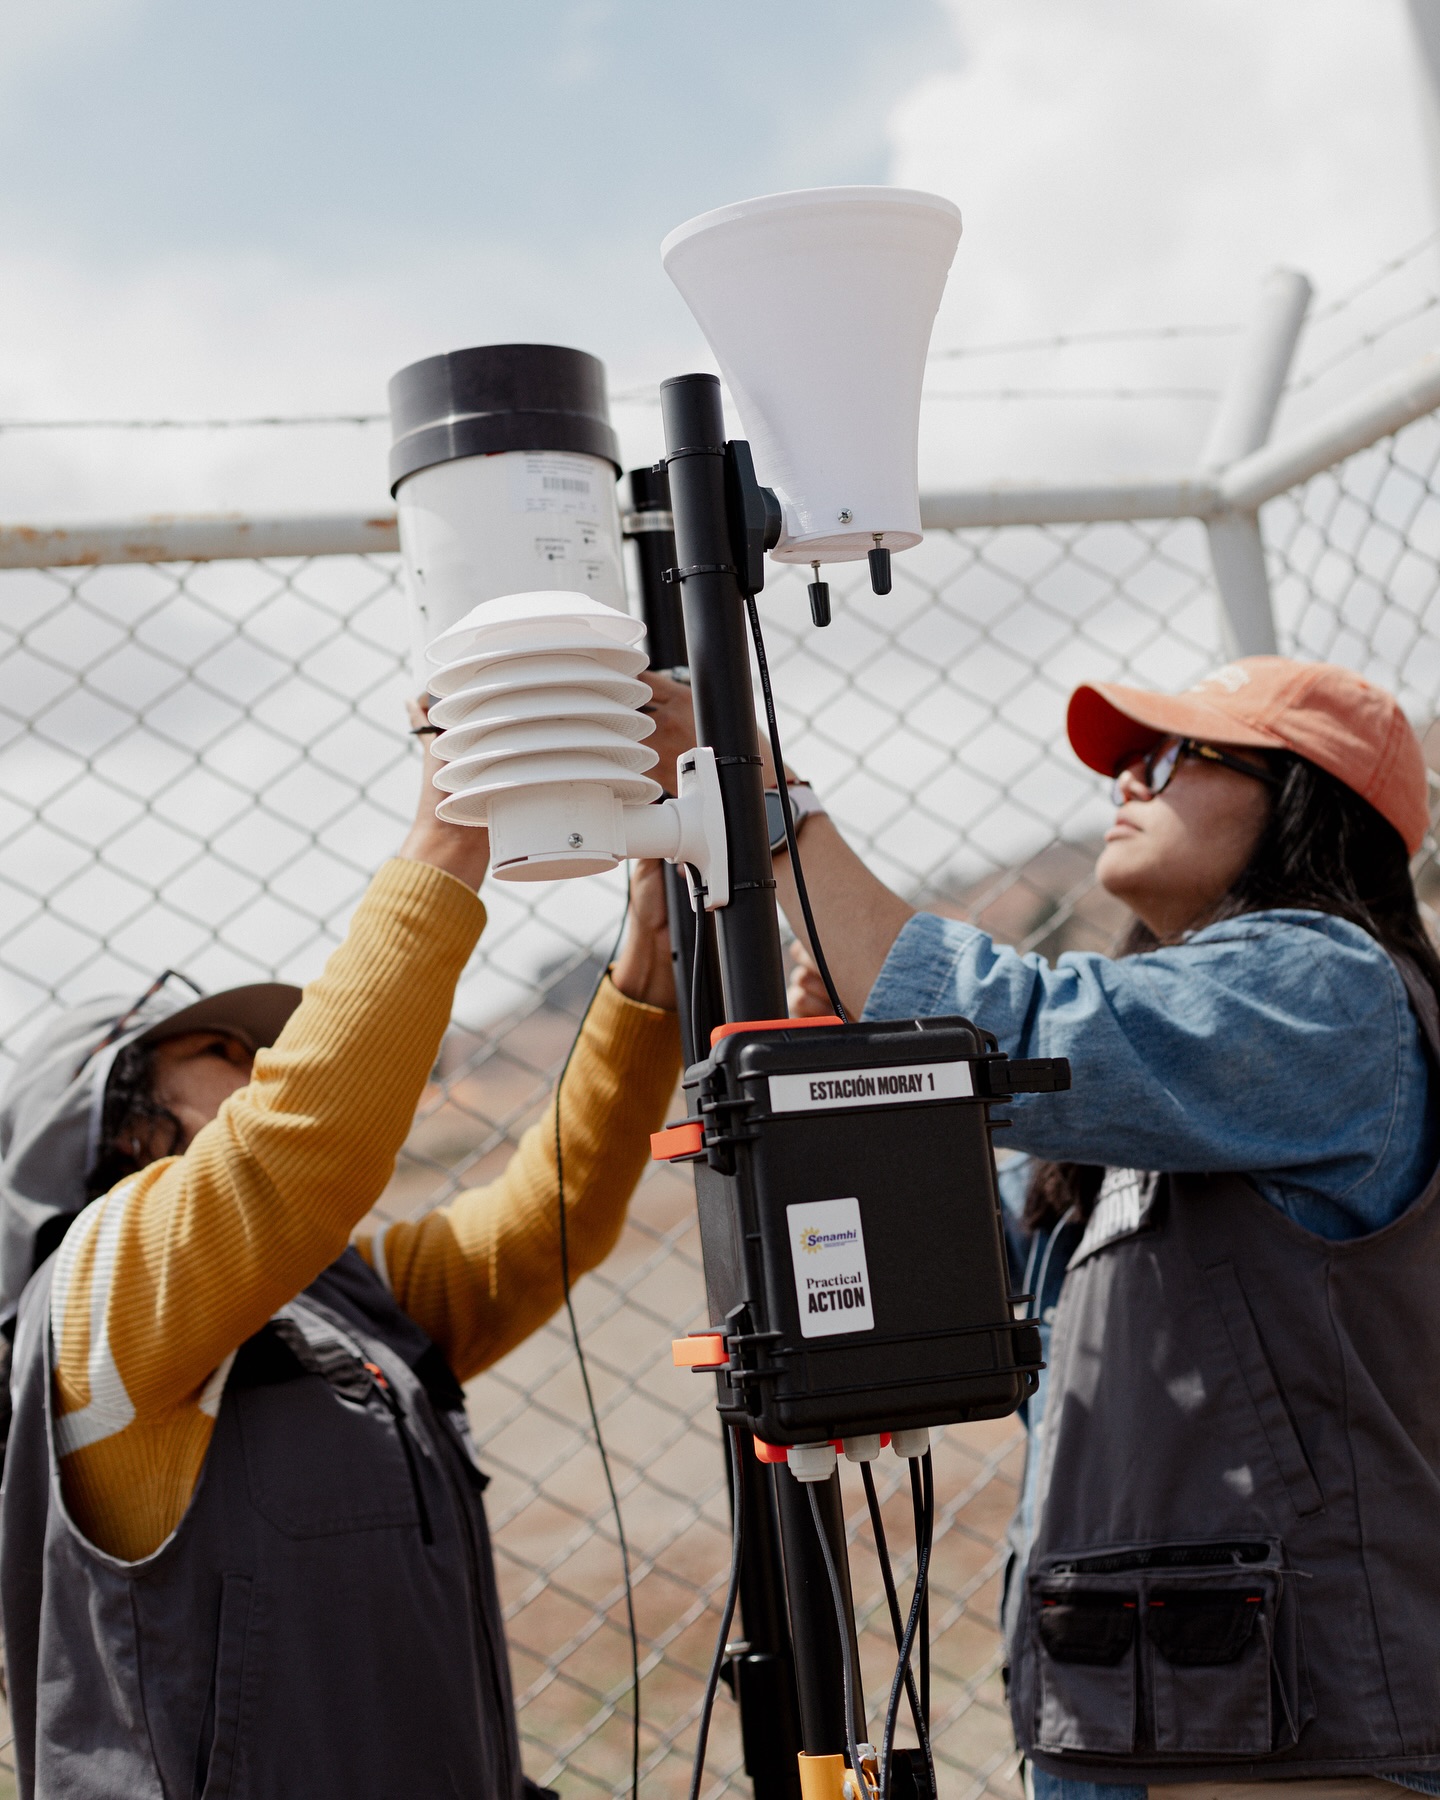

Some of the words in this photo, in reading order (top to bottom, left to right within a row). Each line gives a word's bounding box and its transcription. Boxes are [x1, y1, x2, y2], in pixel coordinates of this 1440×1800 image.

[767, 698, 775, 724] TAIWAN
[809, 1074, 876, 1101] ESTACIÓN
[877, 1073, 923, 1096] MORAY
[927, 1072, 935, 1091] 1
[807, 1229, 857, 1247] Senamhi
[806, 1271, 862, 1290] Practical
[808, 1286, 866, 1314] ACTION
[917, 1547, 928, 1588] HURRICANE
[899, 1593, 920, 1662] MULTI-CONDUCTOR
[889, 1666, 901, 1710] COMPUTER
[910, 1675, 922, 1718] COMPUTER
